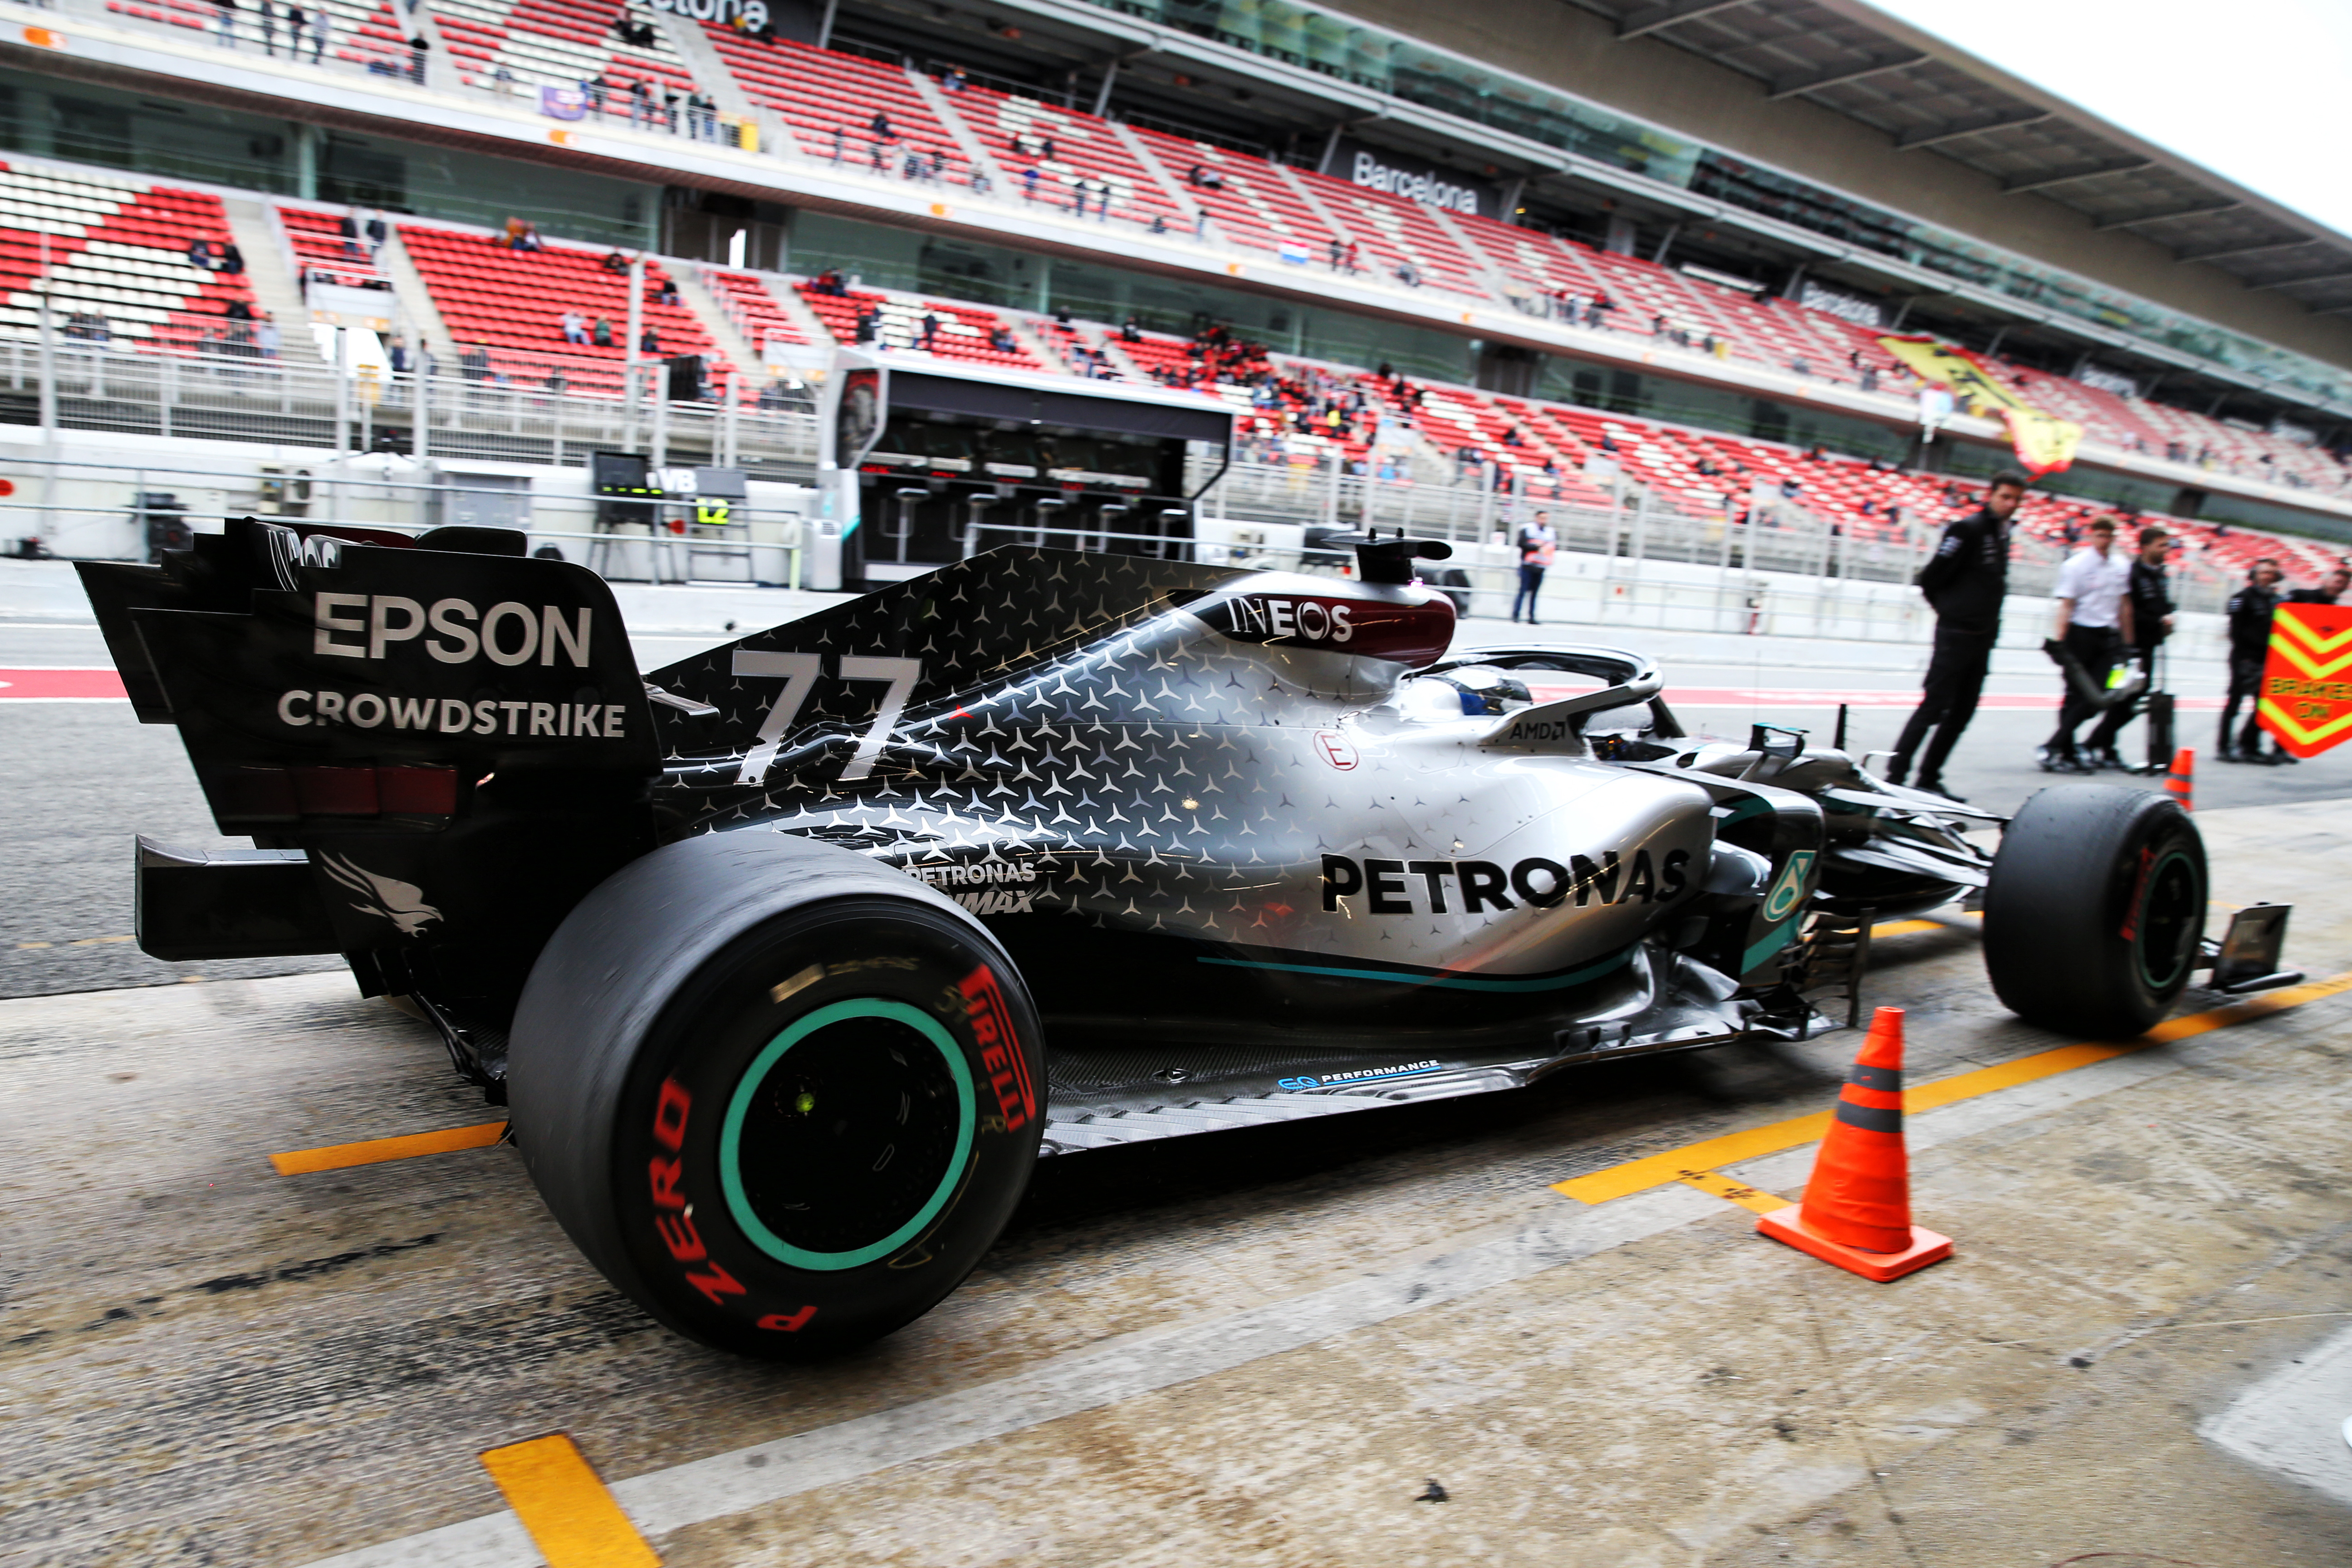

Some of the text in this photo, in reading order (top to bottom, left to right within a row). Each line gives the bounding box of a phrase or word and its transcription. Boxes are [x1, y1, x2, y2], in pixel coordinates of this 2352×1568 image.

[1353, 151, 1478, 215] Barcelona
[658, 468, 698, 493] VB
[696, 498, 729, 525] L2
[314, 592, 592, 667] EPSON
[1223, 597, 1353, 642] INEOS
[277, 690, 627, 738] CROWDSTRIKE
[731, 650, 922, 787] 77
[1509, 721, 1551, 740] AMD
[1320, 735, 1352, 765] E
[906, 862, 1036, 886] PETRONAS
[1321, 849, 1691, 914] PETRONAS
[957, 962, 1036, 1133] PIRELLI
[1278, 1076, 1321, 1089] EQ
[1321, 1060, 1440, 1082] PERFORMANCE
[649, 1075, 818, 1332] P ZERO
